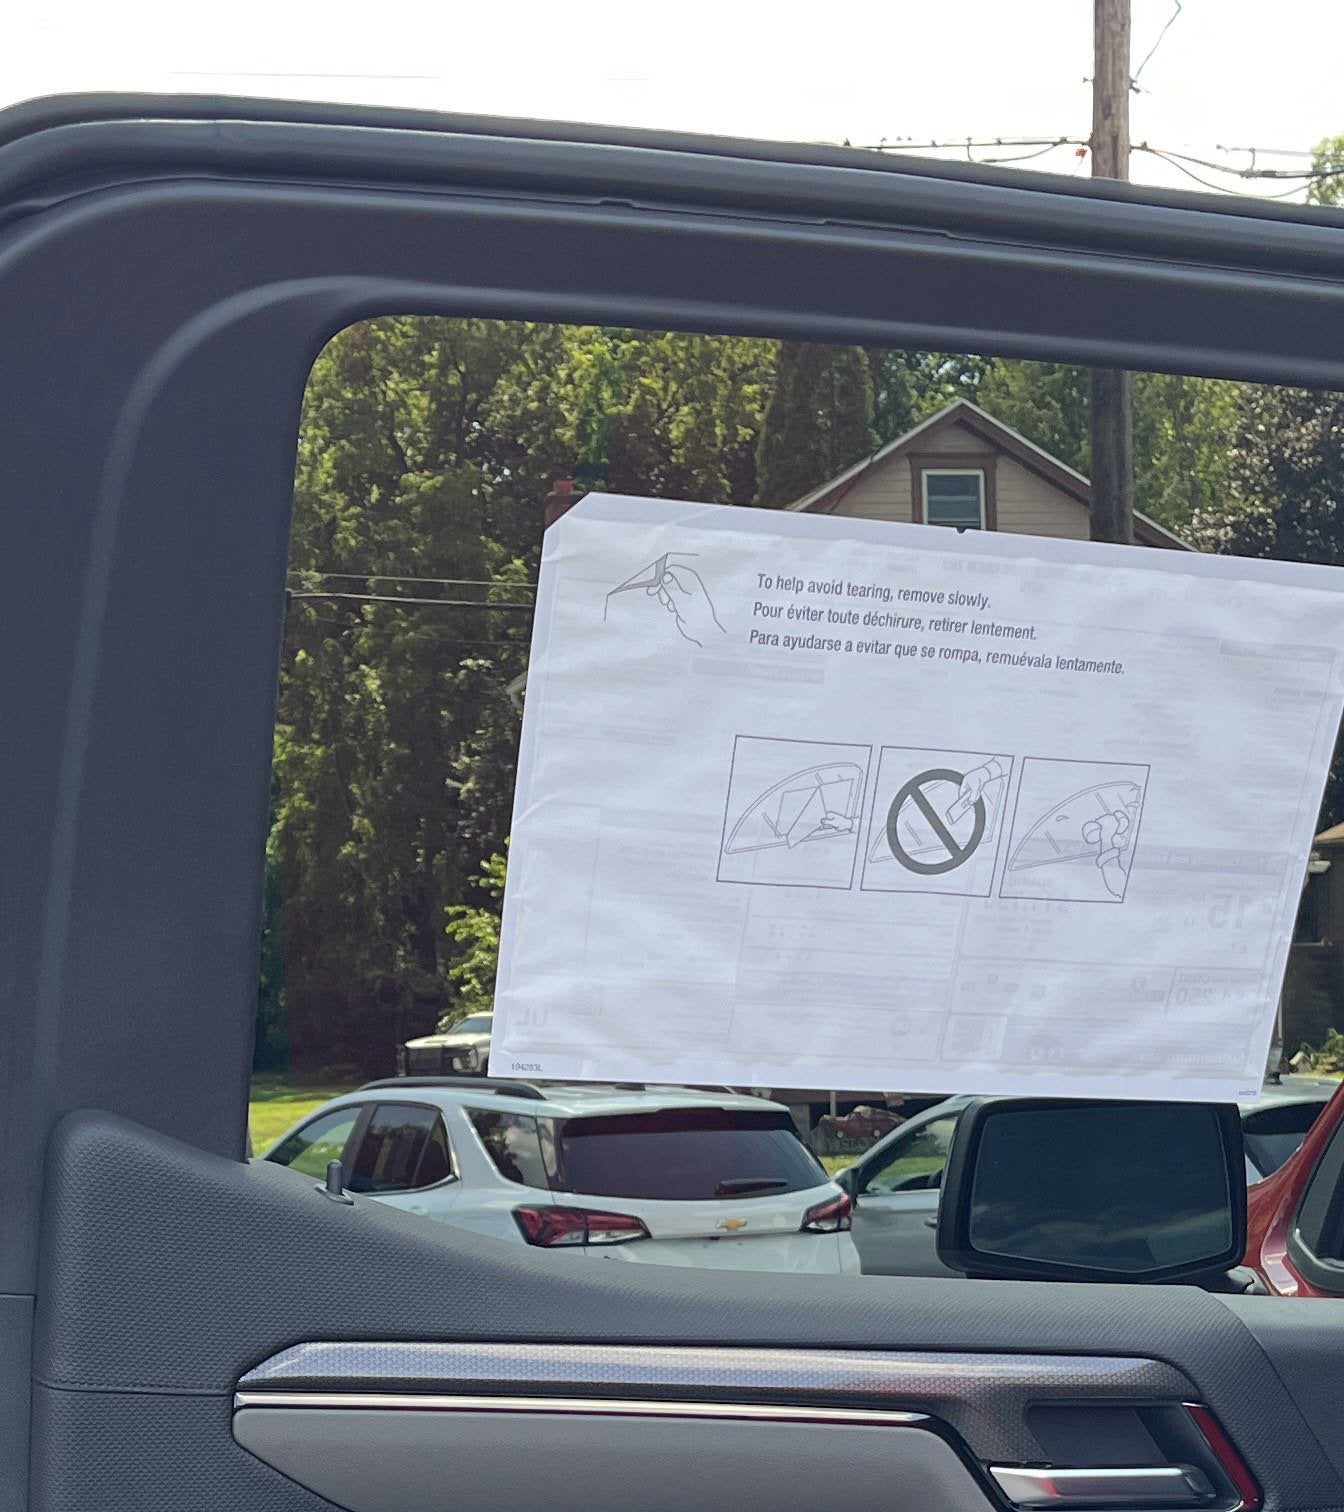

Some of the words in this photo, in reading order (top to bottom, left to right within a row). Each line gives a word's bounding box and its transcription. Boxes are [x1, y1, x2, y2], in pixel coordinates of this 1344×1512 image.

[757, 573, 773, 590] To
[776, 575, 804, 595] help
[807, 579, 843, 596] avoid
[847, 581, 894, 602] tearing,
[897, 589, 944, 605] remove
[948, 590, 991, 611] slowly.
[753, 602, 784, 619] Pour
[787, 604, 824, 622] éviter
[827, 608, 859, 626] toute
[863, 611, 925, 632] déchirure,
[928, 616, 968, 634] retirer
[971, 620, 1037, 641] lentement.
[749, 629, 779, 646] Para
[783, 634, 841, 651] ayudarse
[844, 639, 853, 653] a
[856, 638, 891, 655] evitar
[894, 643, 917, 659] que
[921, 645, 935, 659] se
[939, 647, 982, 665] rompa,
[986, 651, 1052, 669] remuévala
[1056, 655, 1125, 675] lentamente.
